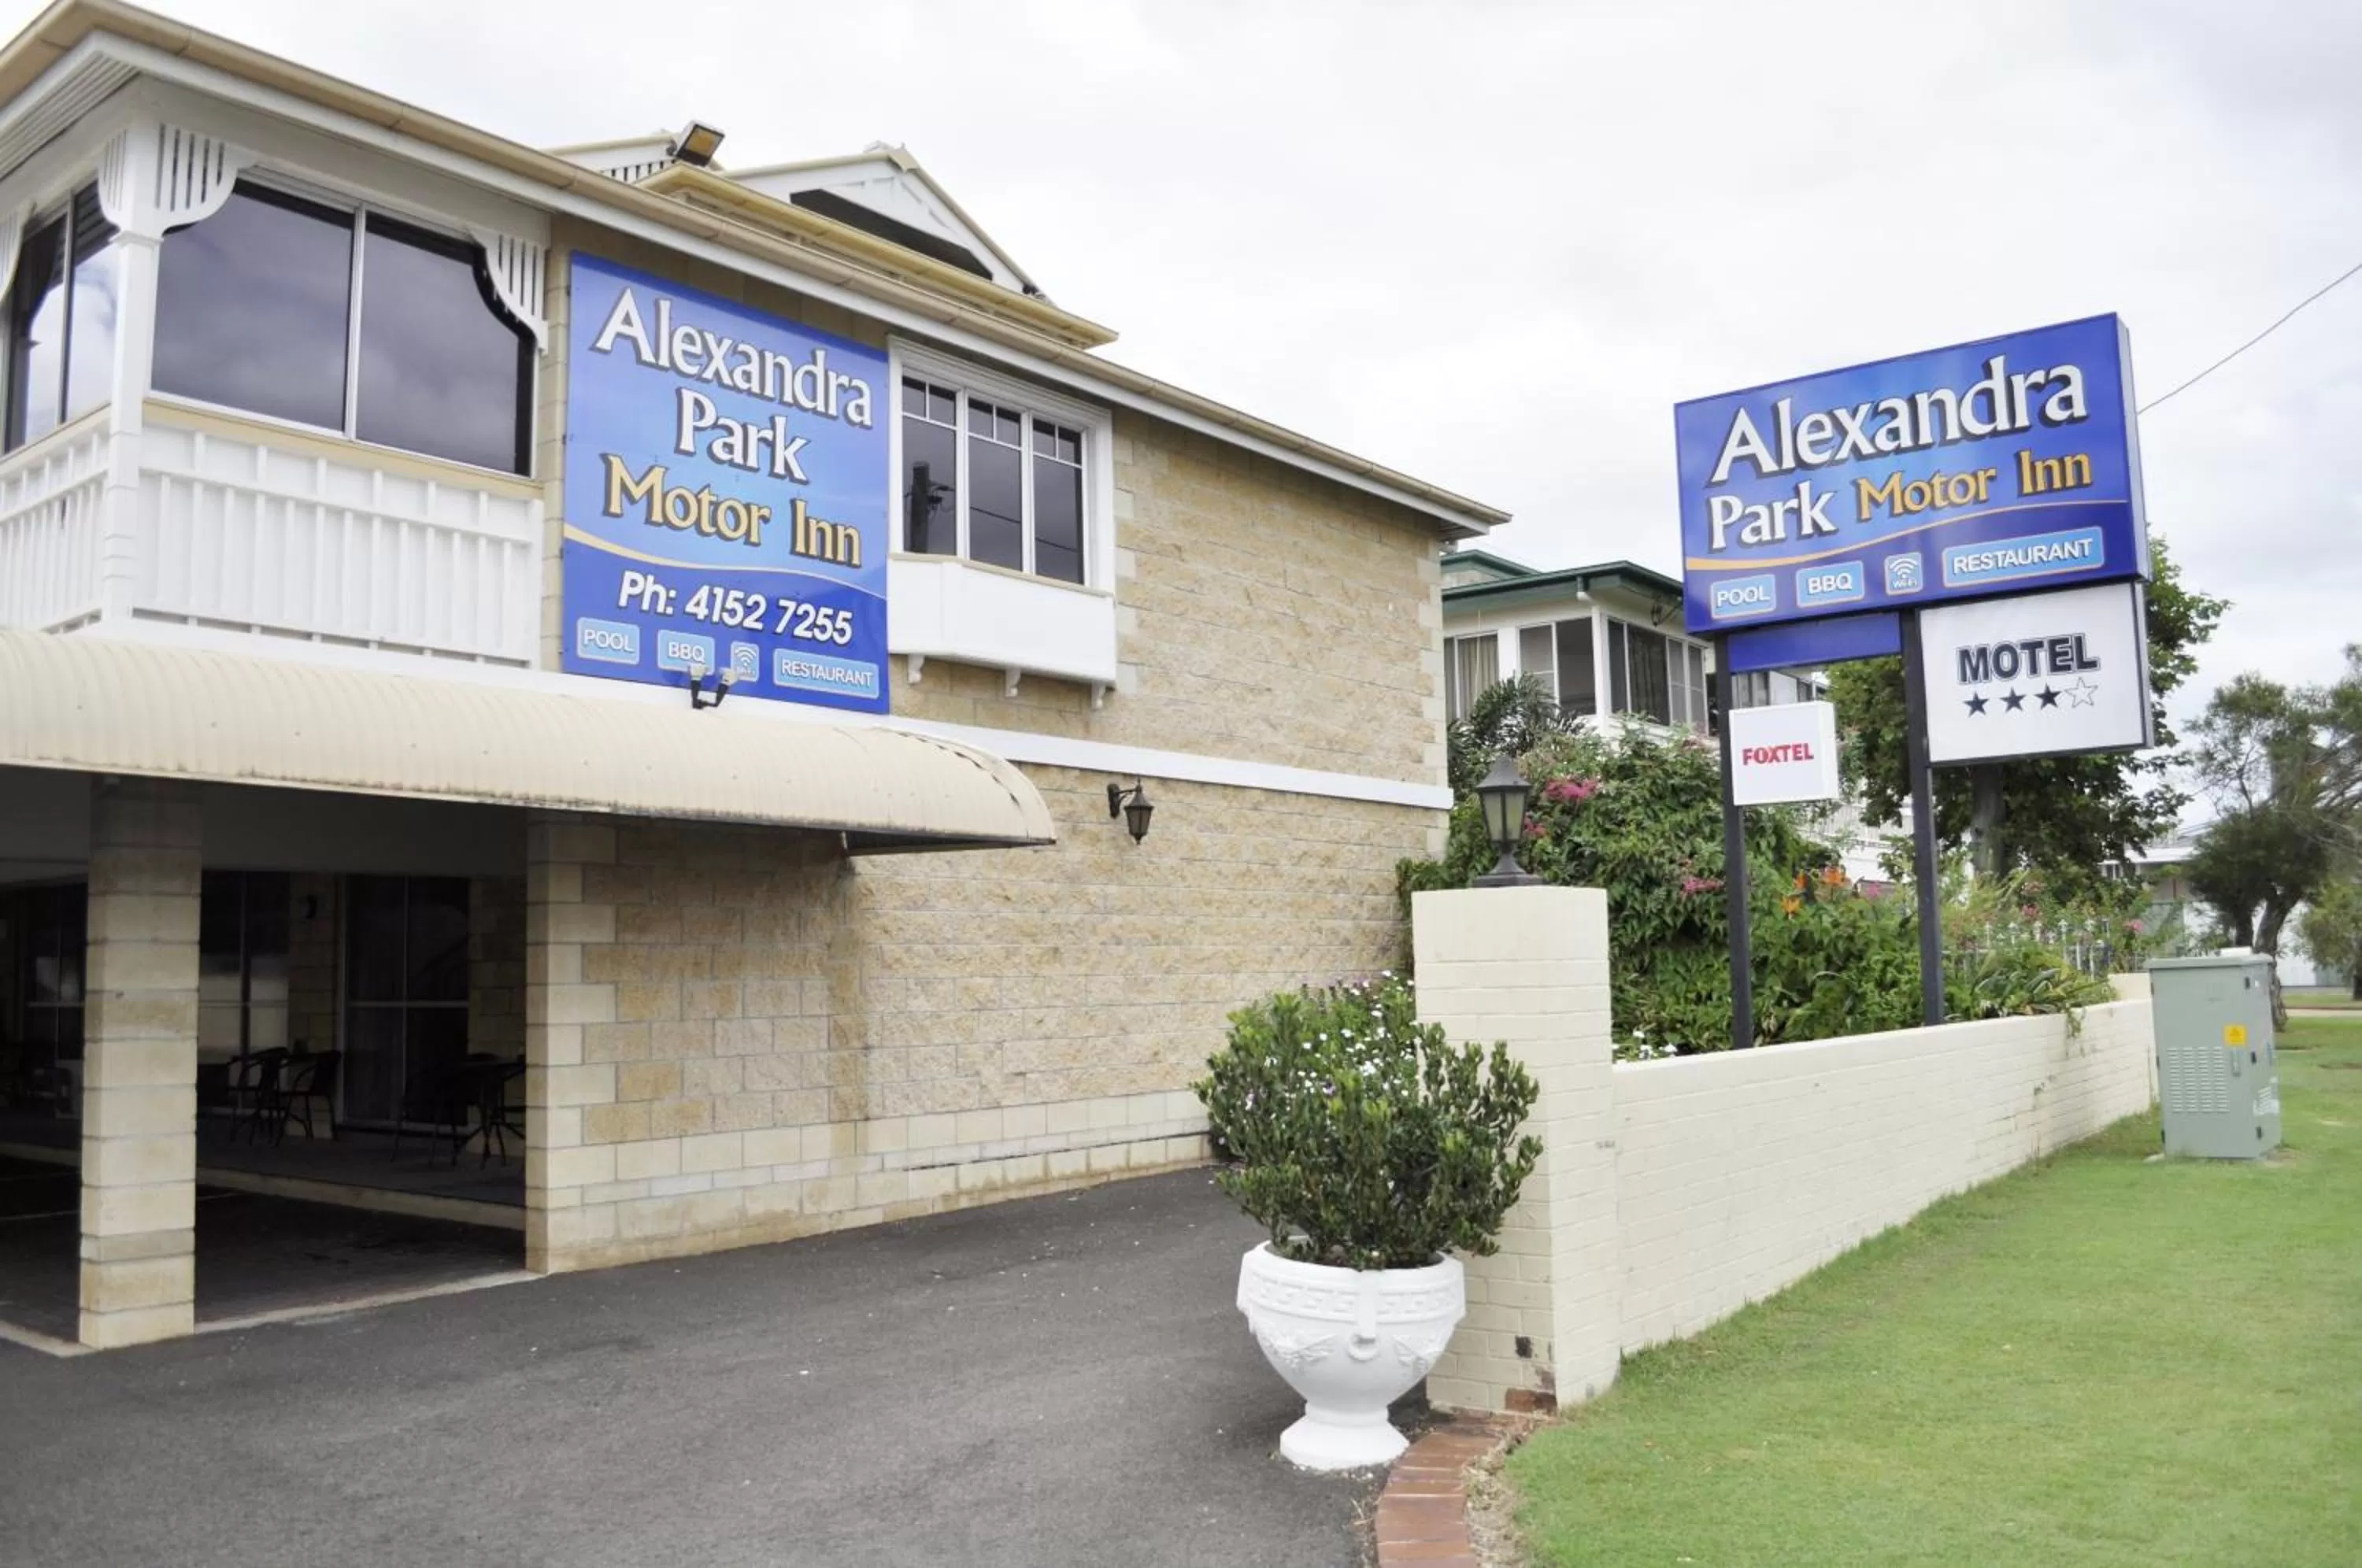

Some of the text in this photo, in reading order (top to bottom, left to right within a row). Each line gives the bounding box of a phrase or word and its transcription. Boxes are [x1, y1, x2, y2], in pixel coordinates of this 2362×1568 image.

[595, 287, 873, 427] Alexandra
[678, 387, 809, 483] Park
[1711, 355, 2089, 483] Alexandra
[605, 455, 861, 567] Motor Inn
[1709, 449, 2093, 549] Park Motor Inn
[1953, 537, 2094, 575] RESTAURANT
[1716, 584, 1771, 607] POOL
[1808, 571, 1853, 595] BBQ
[618, 570, 853, 645] Ph: 4152 7255
[583, 629, 635, 653] POOL
[668, 642, 706, 664] BBQ
[1956, 633, 2101, 685] MOTEL
[781, 659, 875, 688] RESTAURANT
[1742, 742, 1815, 767] FOXTEL
